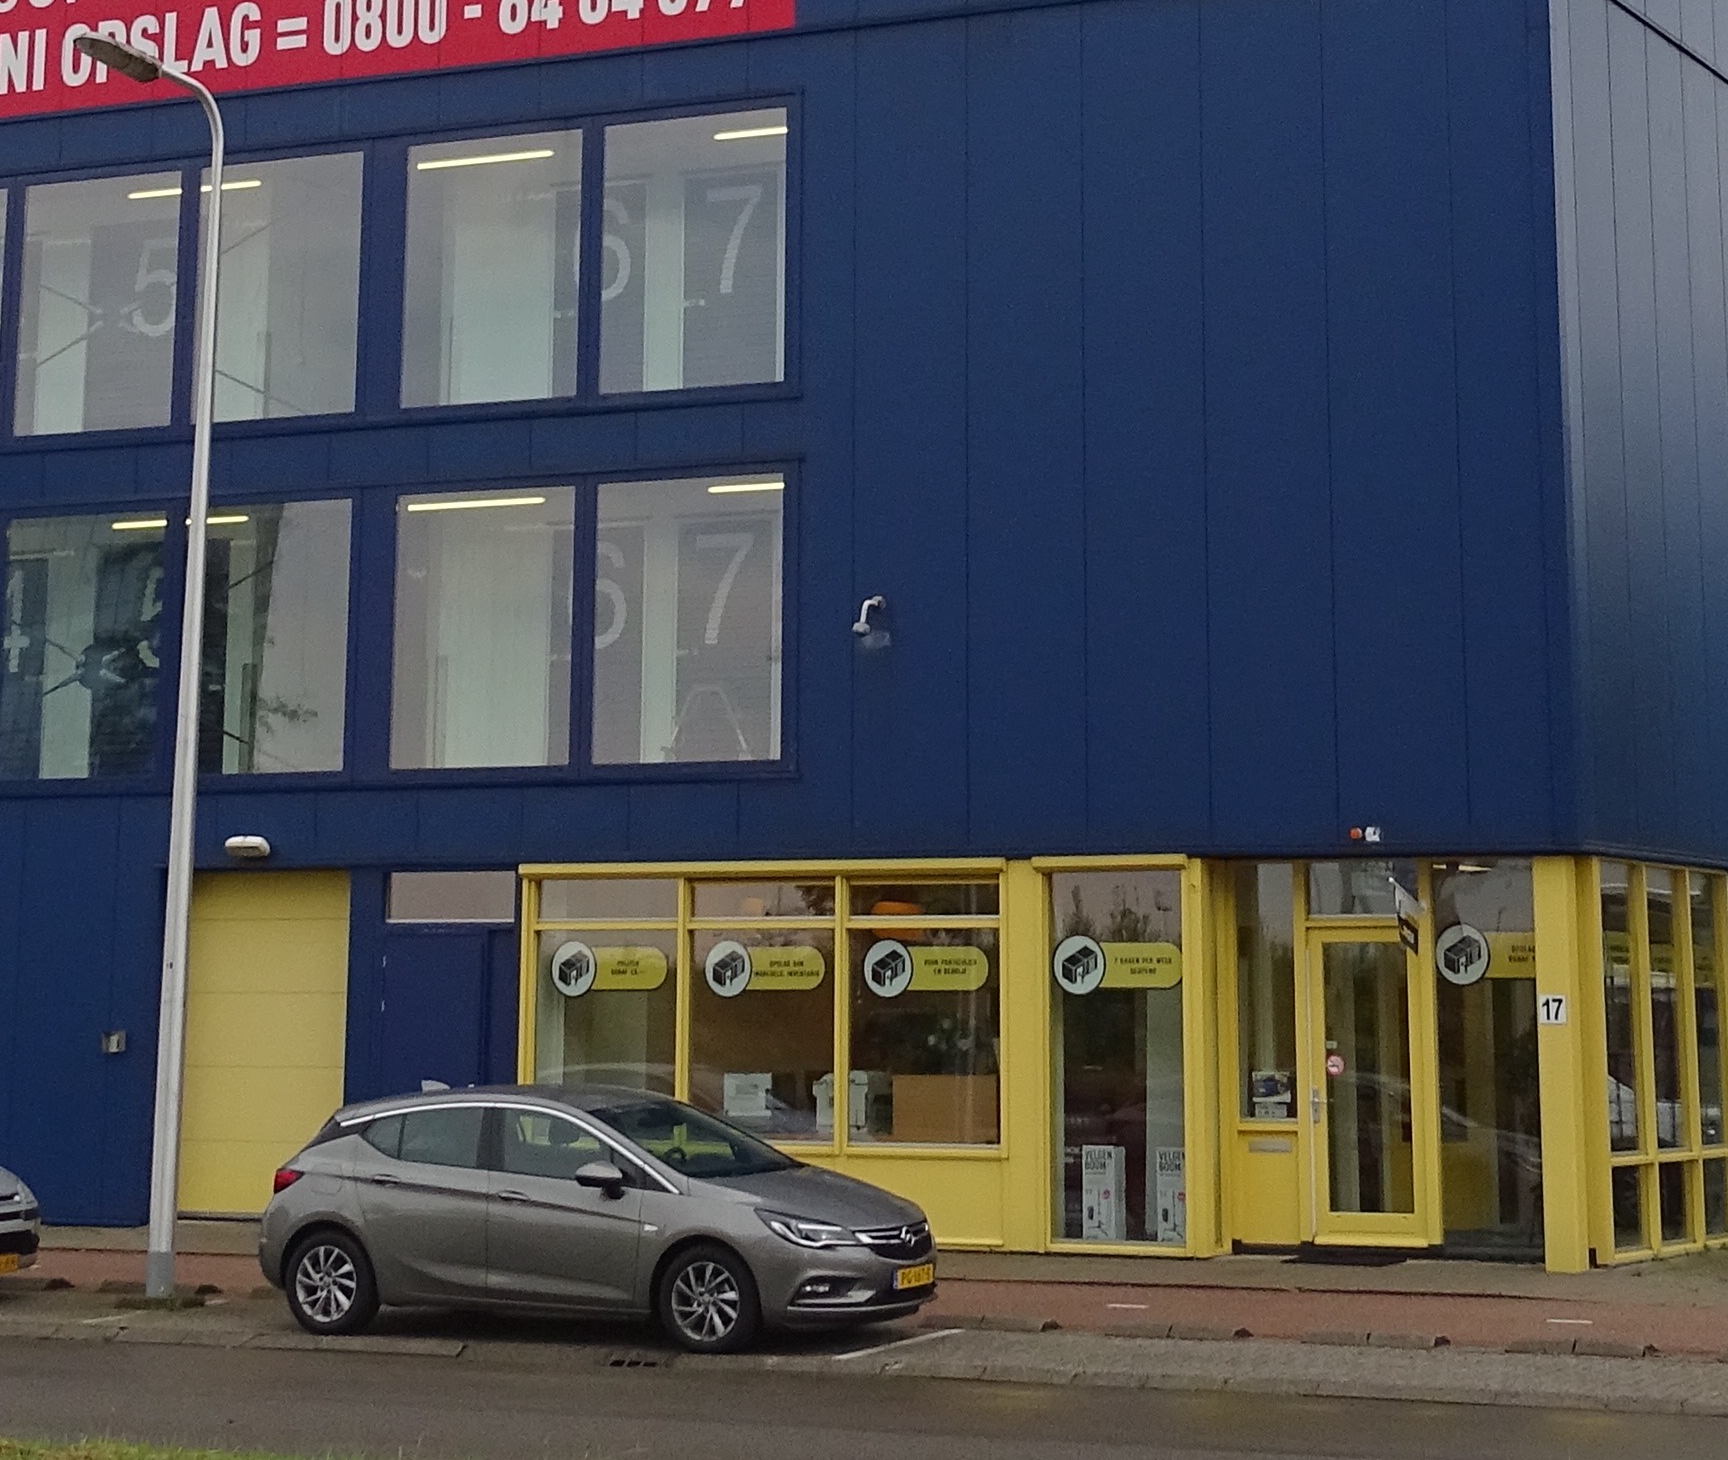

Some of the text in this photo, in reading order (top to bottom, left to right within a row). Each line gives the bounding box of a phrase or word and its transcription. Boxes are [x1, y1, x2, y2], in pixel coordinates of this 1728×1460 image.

[705, 185, 763, 293] 7
[696, 533, 756, 645] 7
[1542, 998, 1563, 1021] 17
